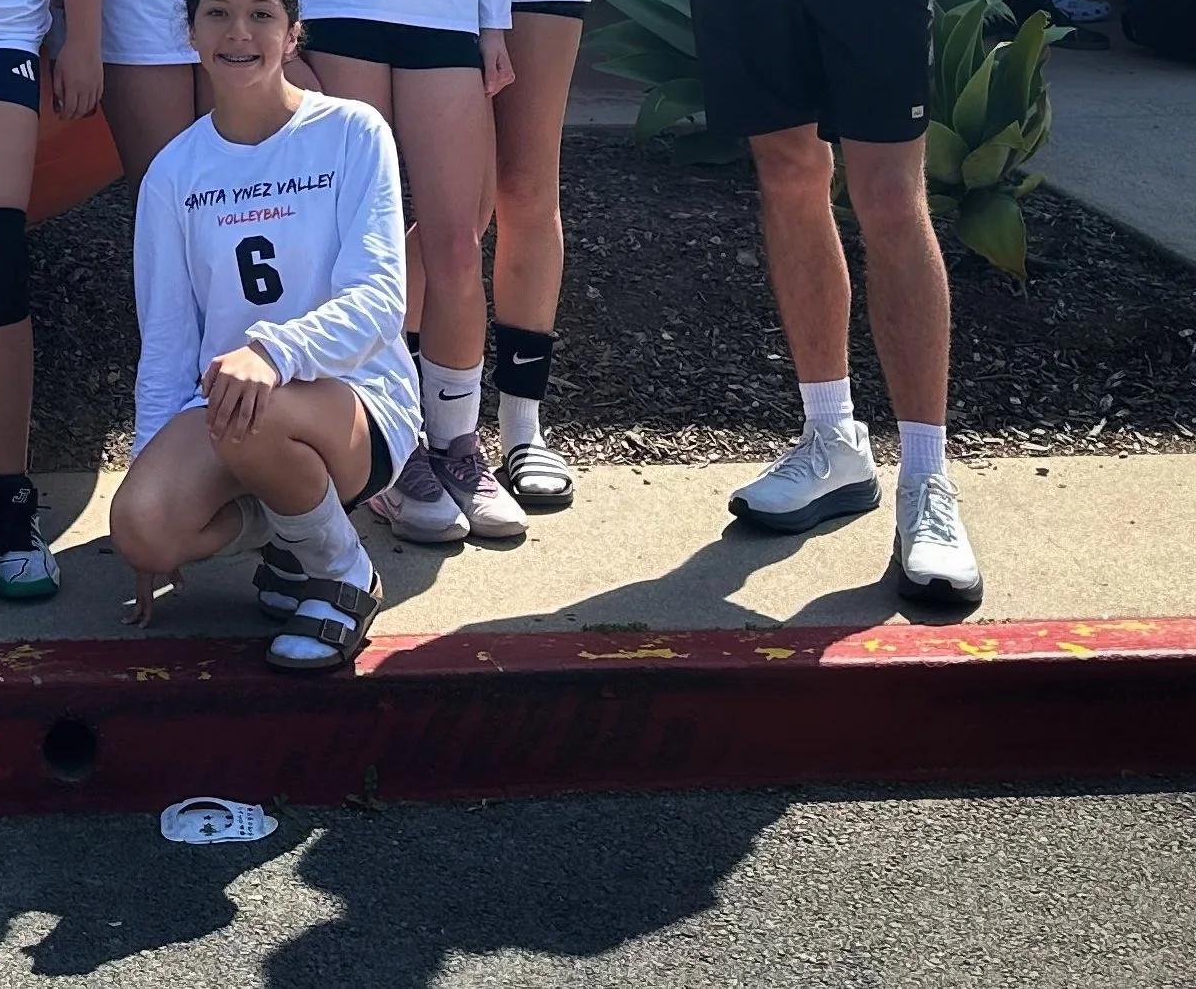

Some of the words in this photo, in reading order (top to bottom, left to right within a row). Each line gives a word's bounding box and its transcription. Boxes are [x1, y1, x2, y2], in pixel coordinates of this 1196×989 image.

[184, 189, 227, 213] SANTA
[232, 182, 273, 204] YNEZ
[276, 171, 335, 195] VALLEY
[217, 205, 296, 226] VOLLEYBALL
[235, 235, 284, 305] 6
